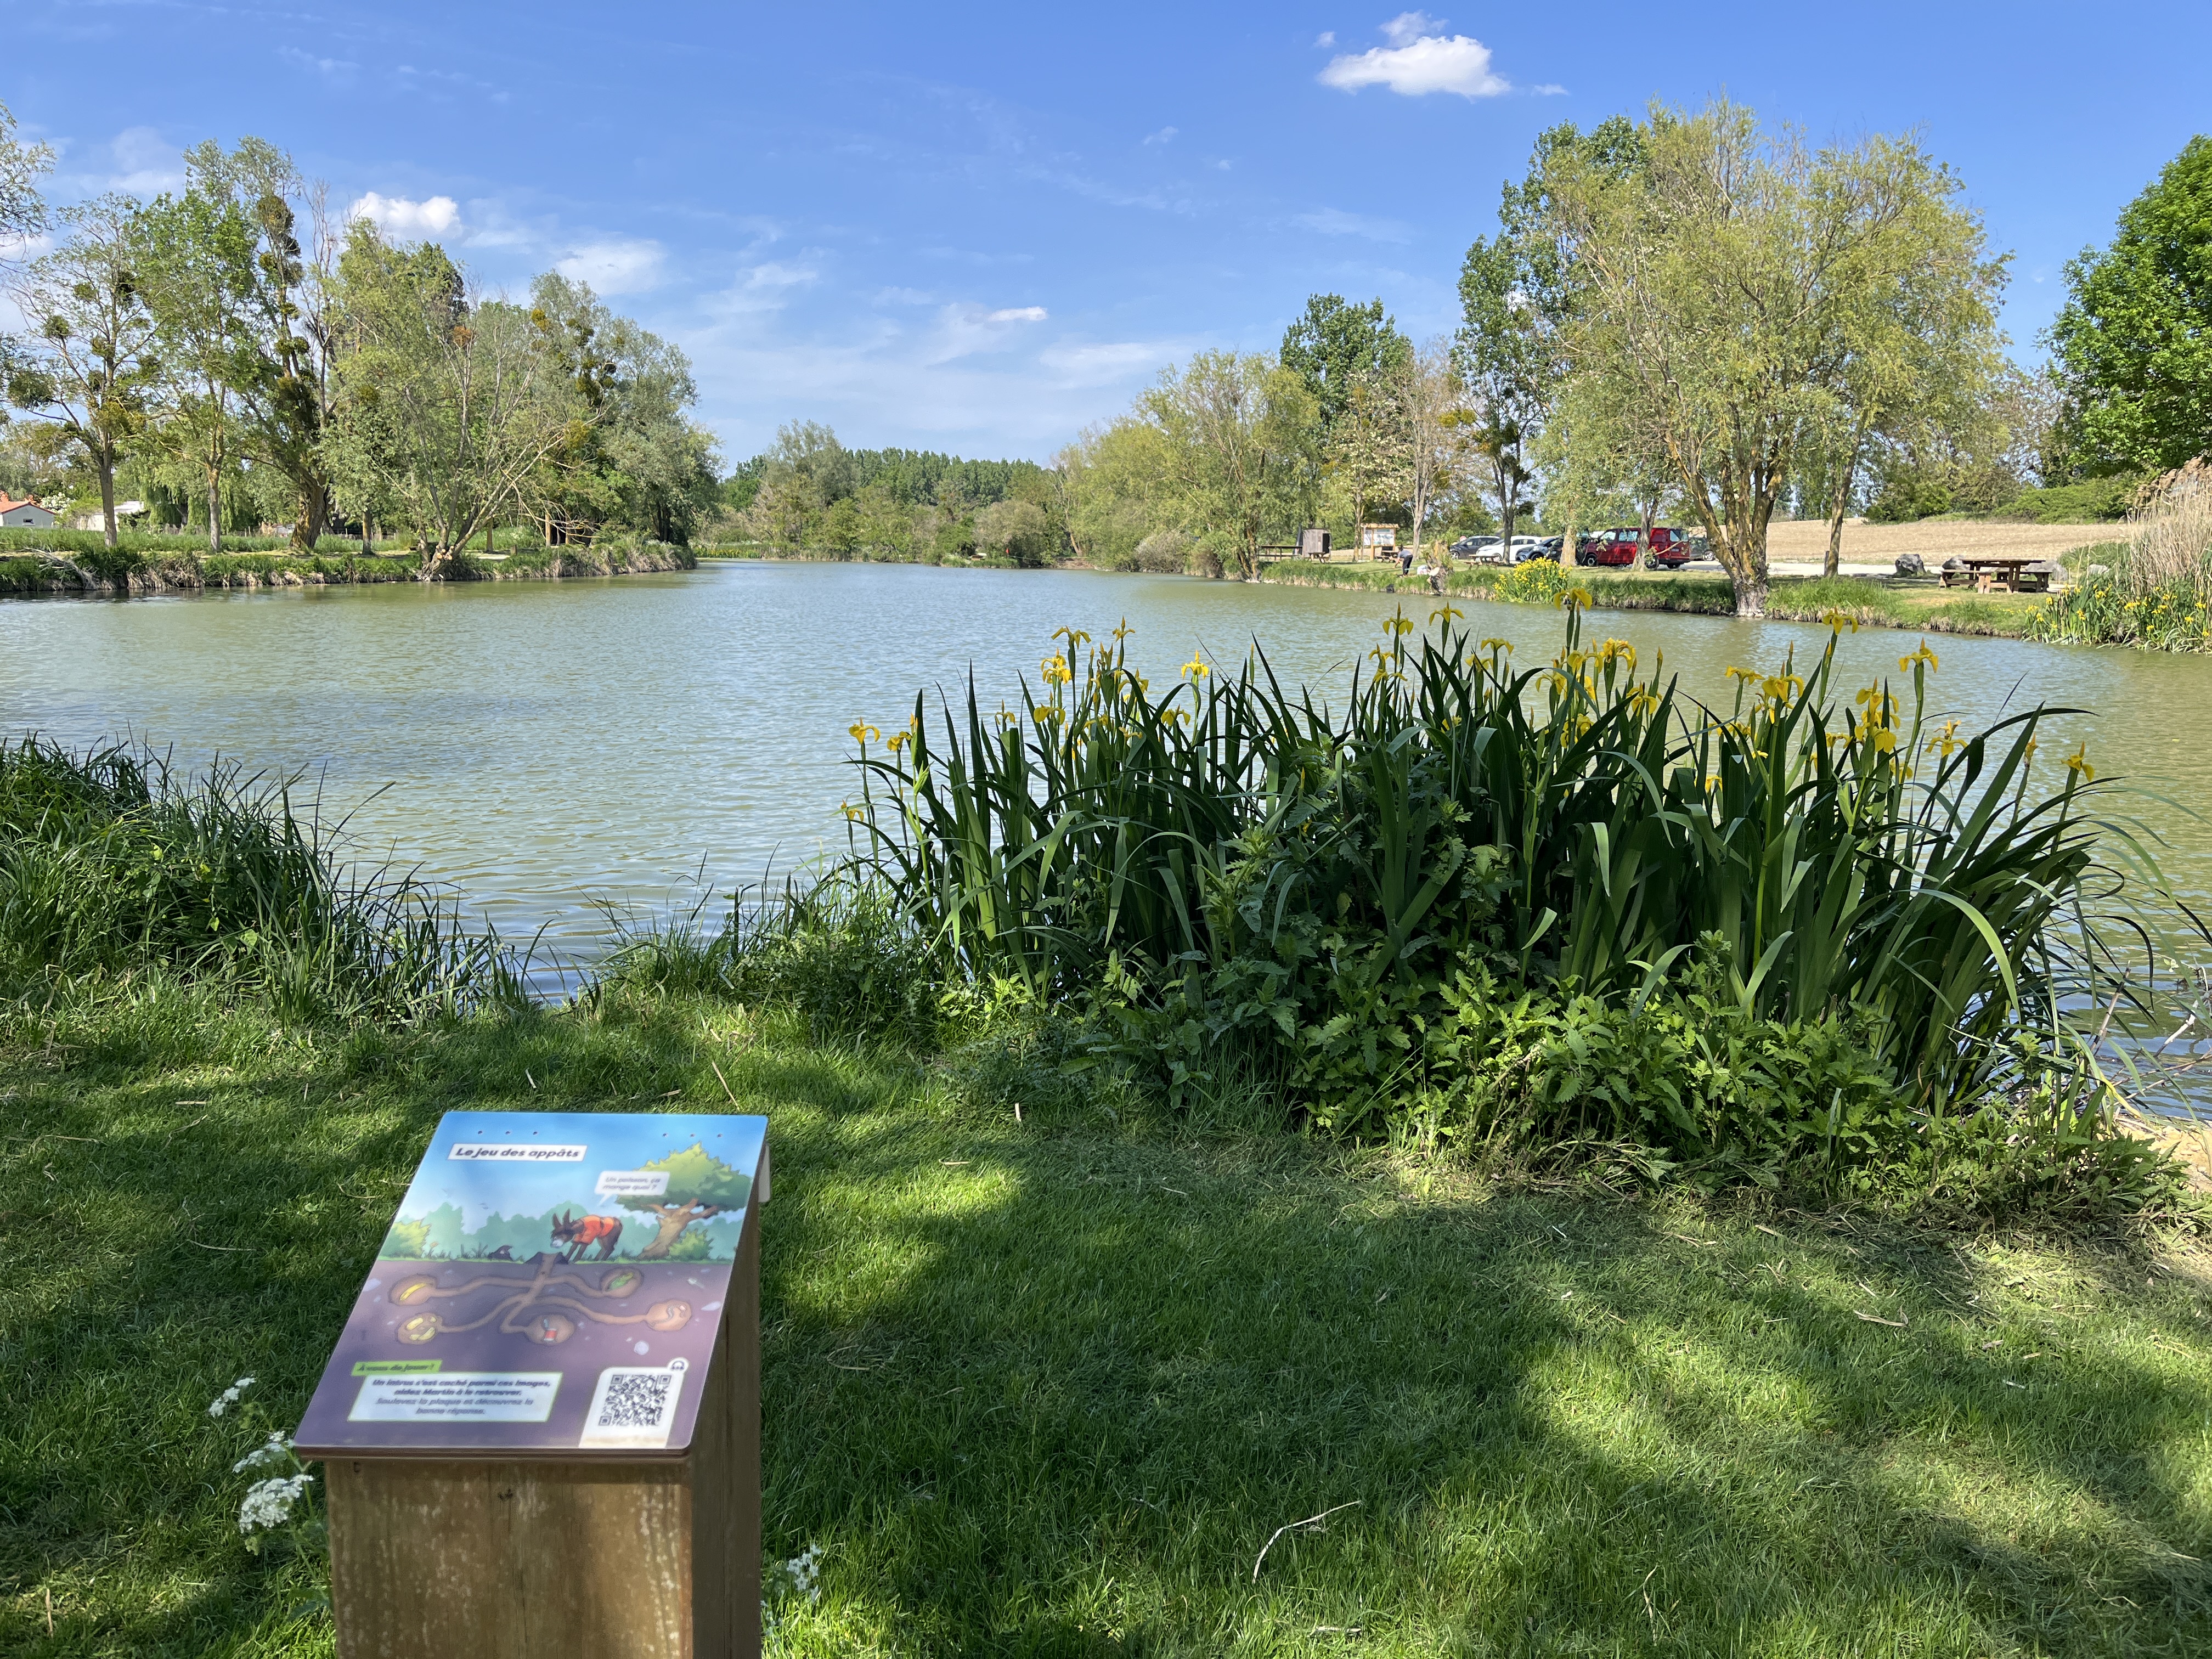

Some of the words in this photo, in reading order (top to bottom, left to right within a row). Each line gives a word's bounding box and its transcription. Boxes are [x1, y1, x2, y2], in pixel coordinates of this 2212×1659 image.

[456, 1148, 472, 1156] Le
[471, 1148, 498, 1158] jeu
[500, 1148, 525, 1156] des
[528, 1149, 579, 1159] appâts
